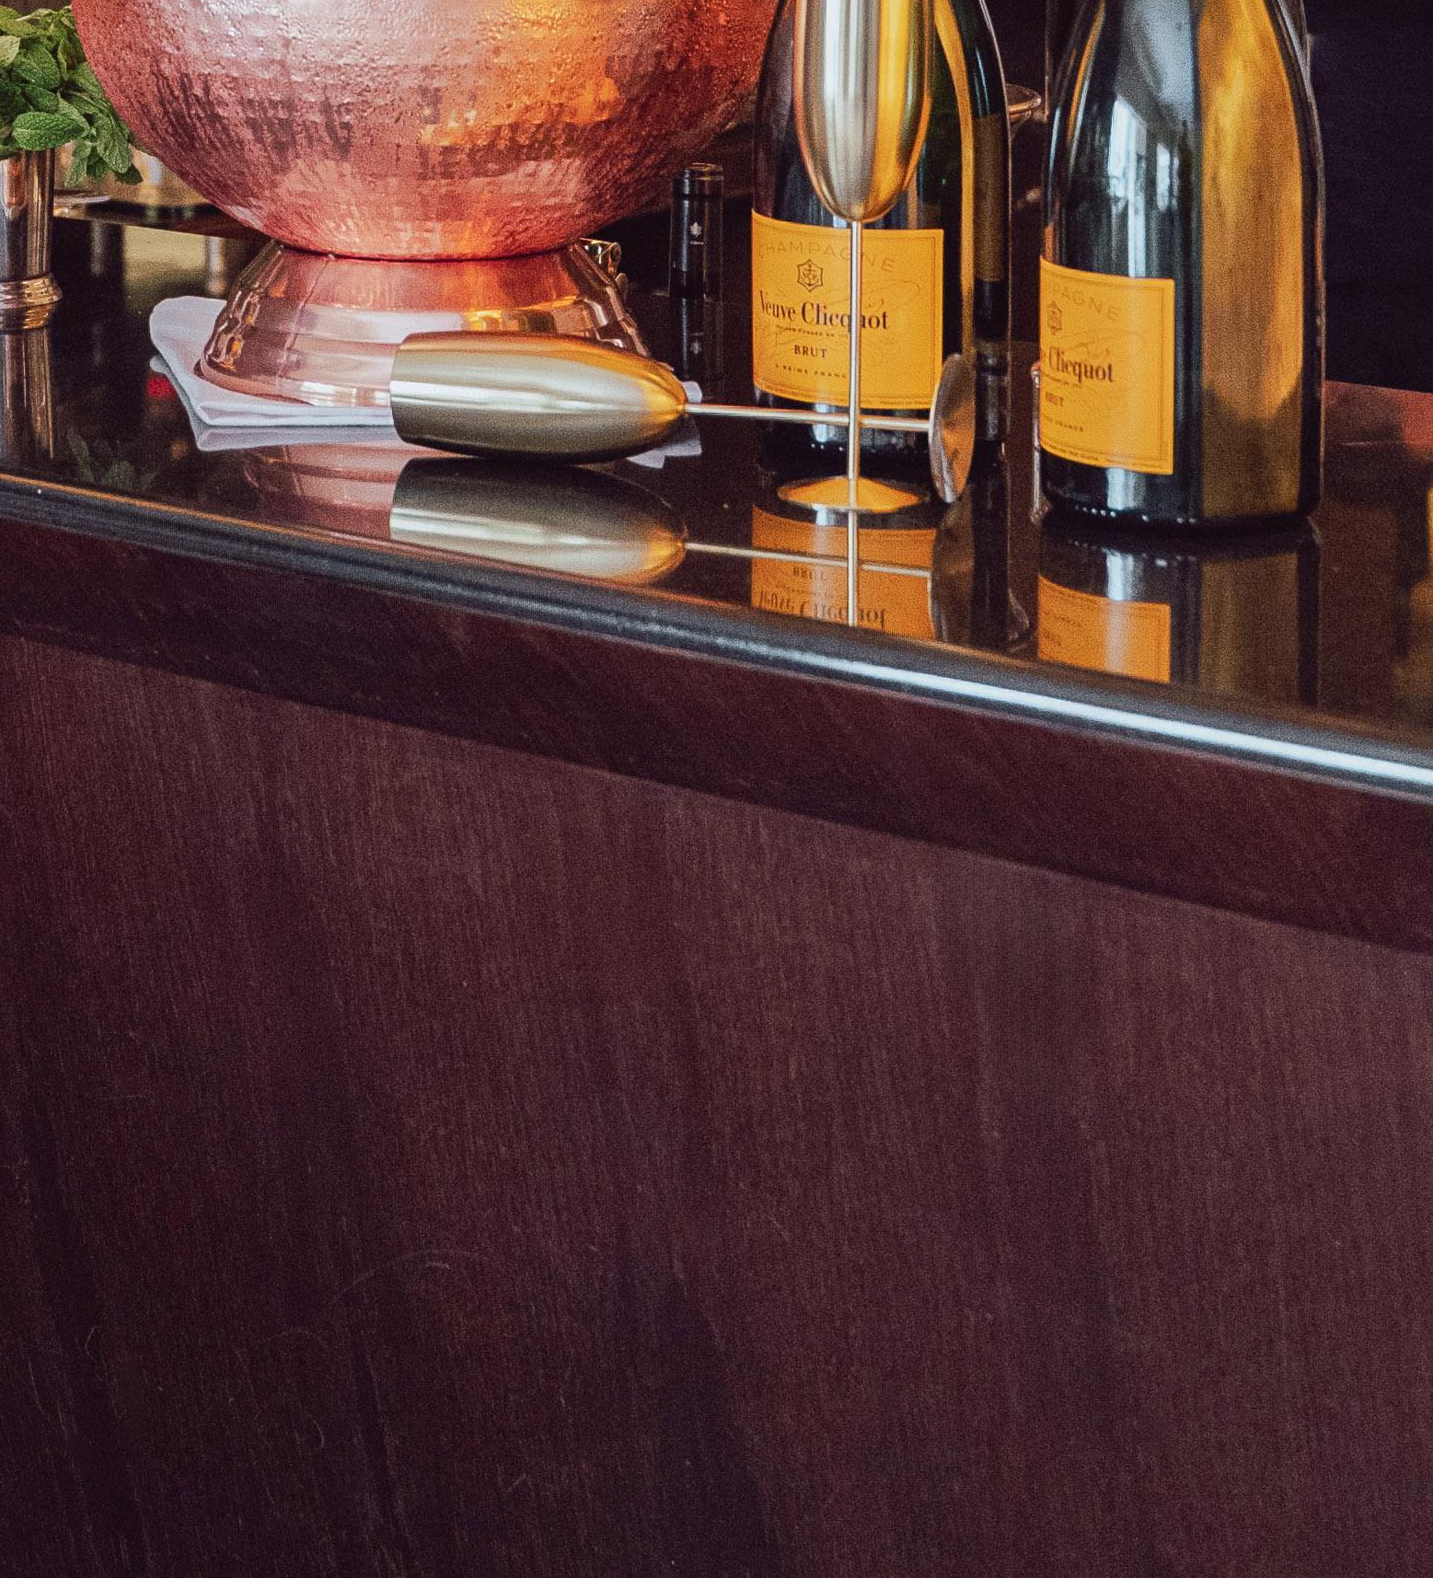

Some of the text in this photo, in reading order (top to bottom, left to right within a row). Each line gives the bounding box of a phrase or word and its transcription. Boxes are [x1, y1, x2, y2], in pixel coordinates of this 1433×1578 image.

[759, 288, 796, 322] Veuve
[794, 344, 828, 359] BRUT
[1048, 344, 1115, 383] Clicquot
